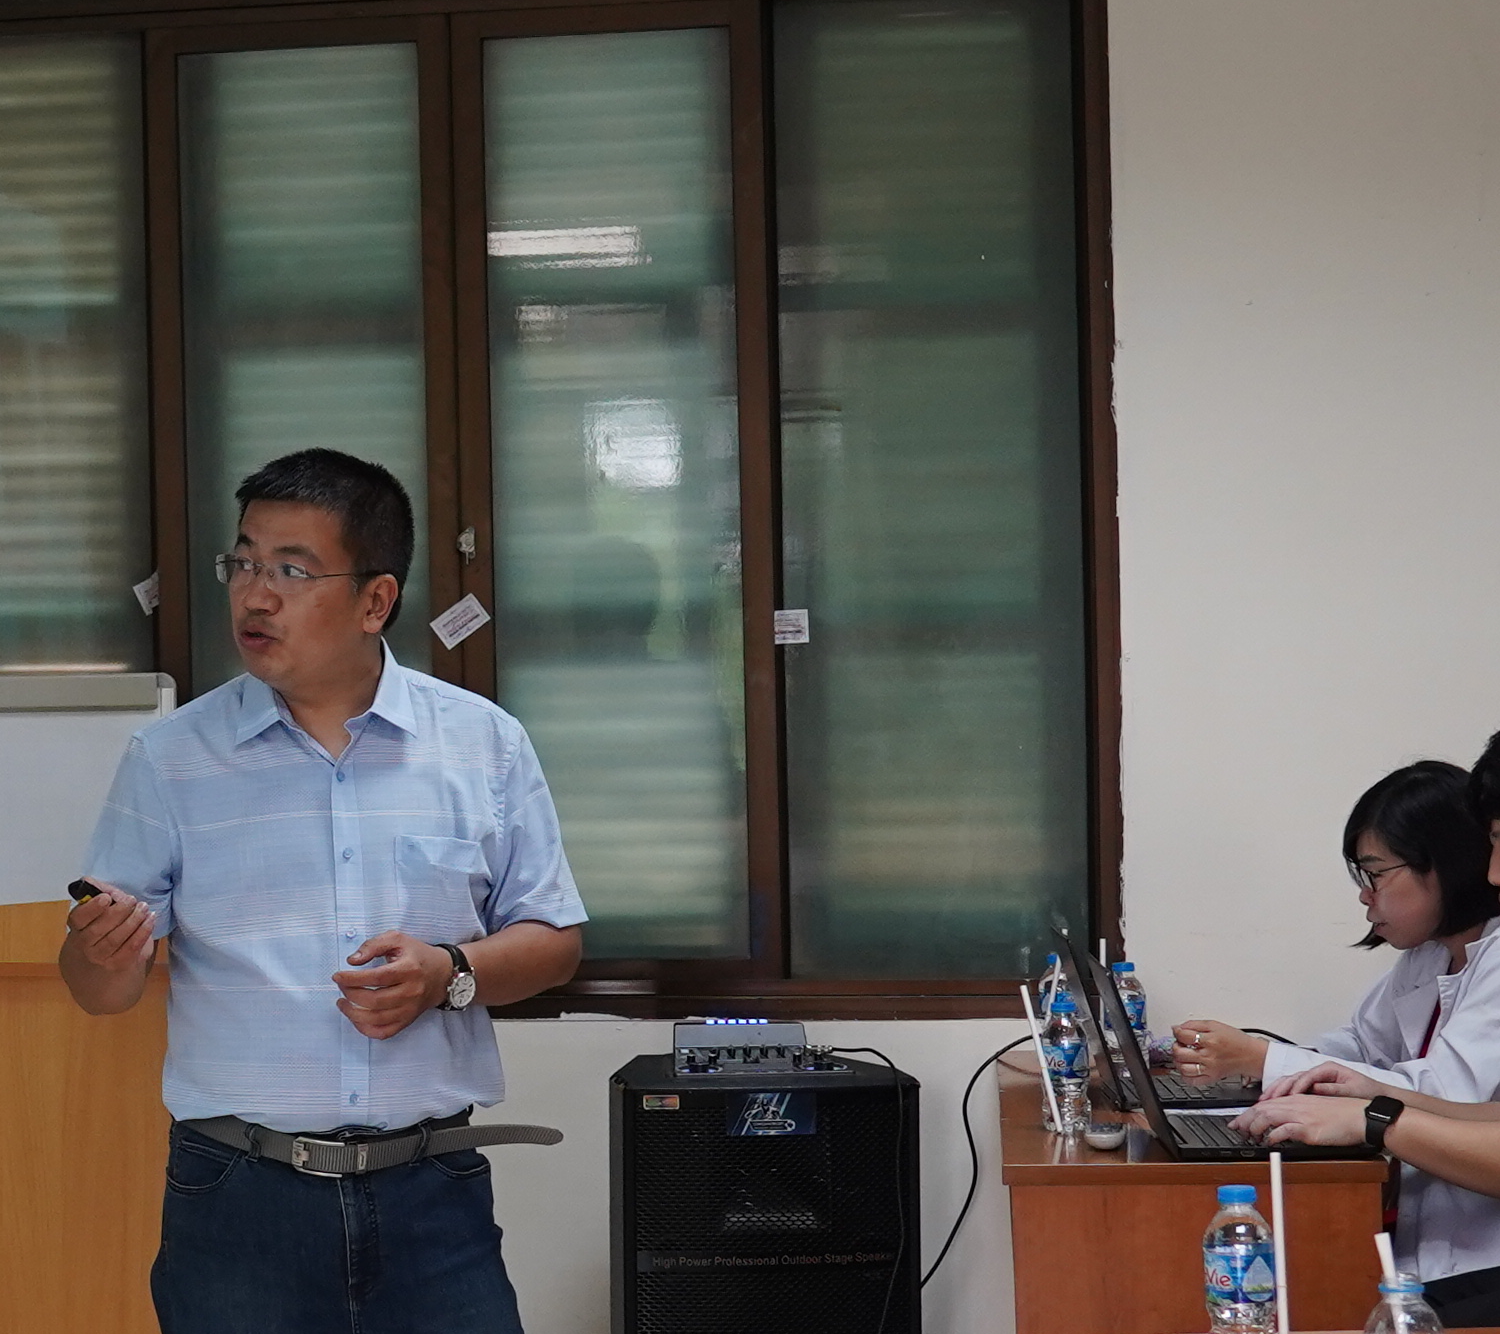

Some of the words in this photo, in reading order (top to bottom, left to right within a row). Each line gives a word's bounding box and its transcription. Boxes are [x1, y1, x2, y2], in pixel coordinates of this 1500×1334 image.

[652, 1256, 677, 1268] High
[679, 1256, 712, 1267] Power
[714, 1255, 779, 1267] Professional
[781, 1254, 824, 1265] Outdoor
[824, 1253, 853, 1265] Stage
